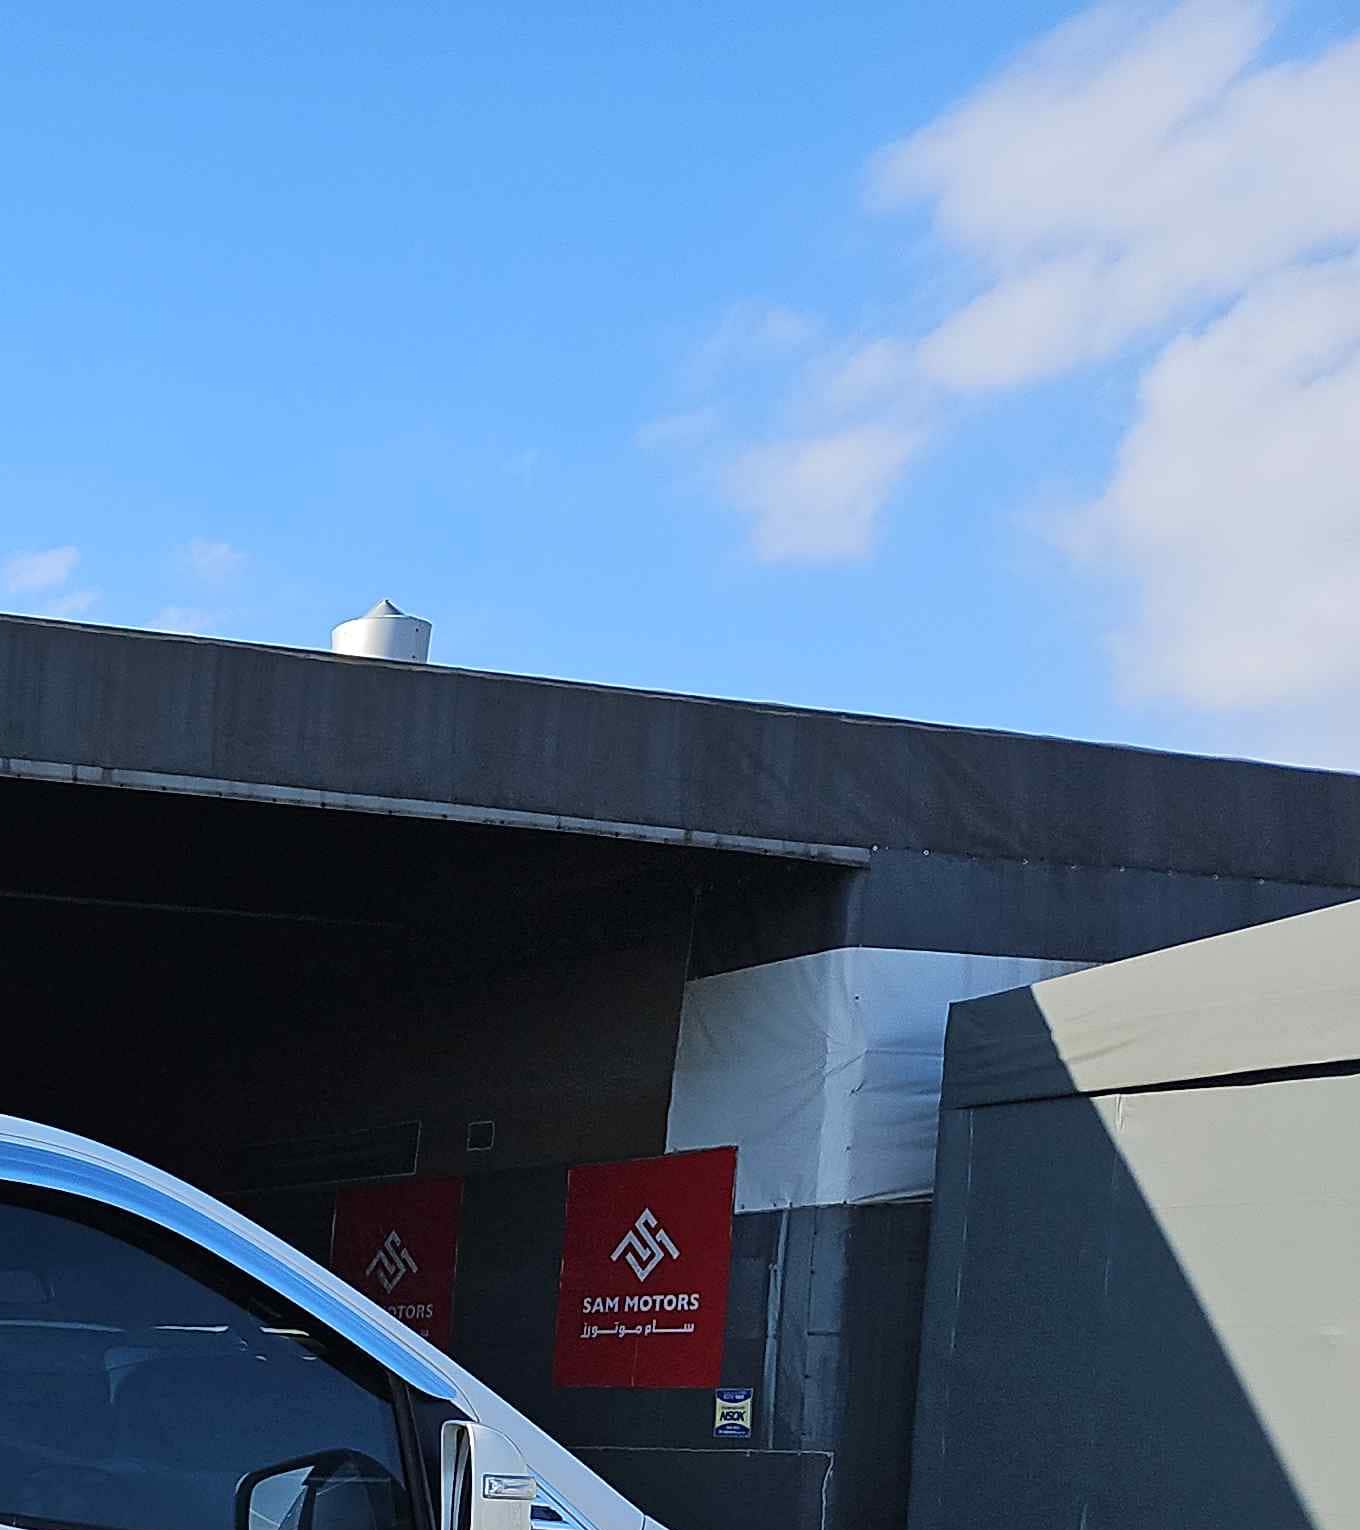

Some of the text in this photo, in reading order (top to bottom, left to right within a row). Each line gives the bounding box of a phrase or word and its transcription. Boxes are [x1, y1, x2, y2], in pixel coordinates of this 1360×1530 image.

[385, 1303, 434, 1320] OTORS
[582, 1293, 700, 1314] SAM MOTORS
